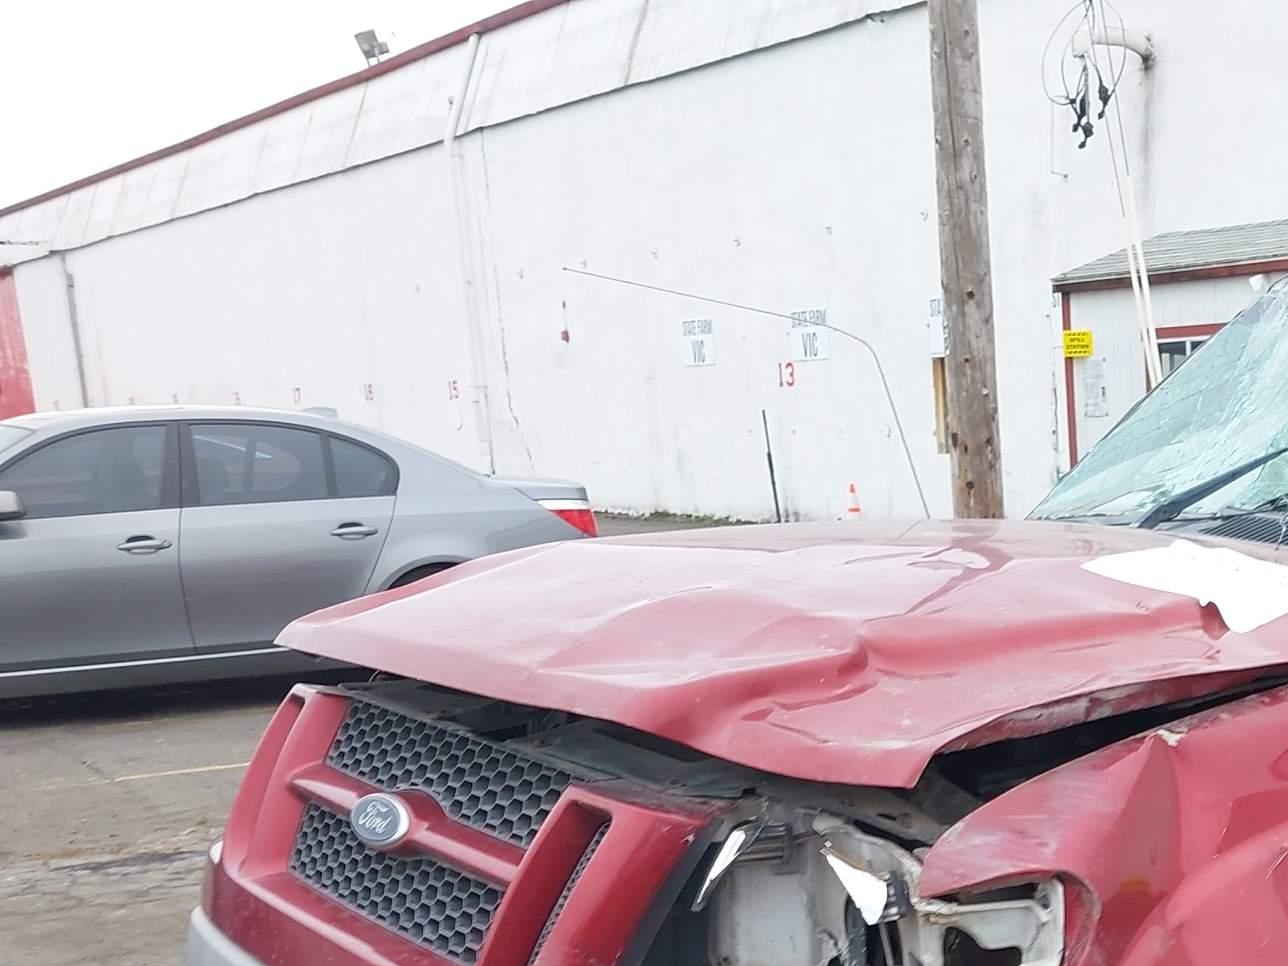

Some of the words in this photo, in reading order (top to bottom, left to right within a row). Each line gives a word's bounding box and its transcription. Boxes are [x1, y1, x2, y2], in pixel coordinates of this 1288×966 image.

[682, 320, 696, 336] STATE
[697, 319, 712, 335] FARM
[790, 311, 807, 329] STATE
[808, 309, 826, 325] FARM
[691, 339, 706, 364] VIC
[801, 331, 818, 358] VIC
[778, 362, 795, 387] 13
[448, 380, 459, 400] 15
[359, 801, 393, 834] Ford
